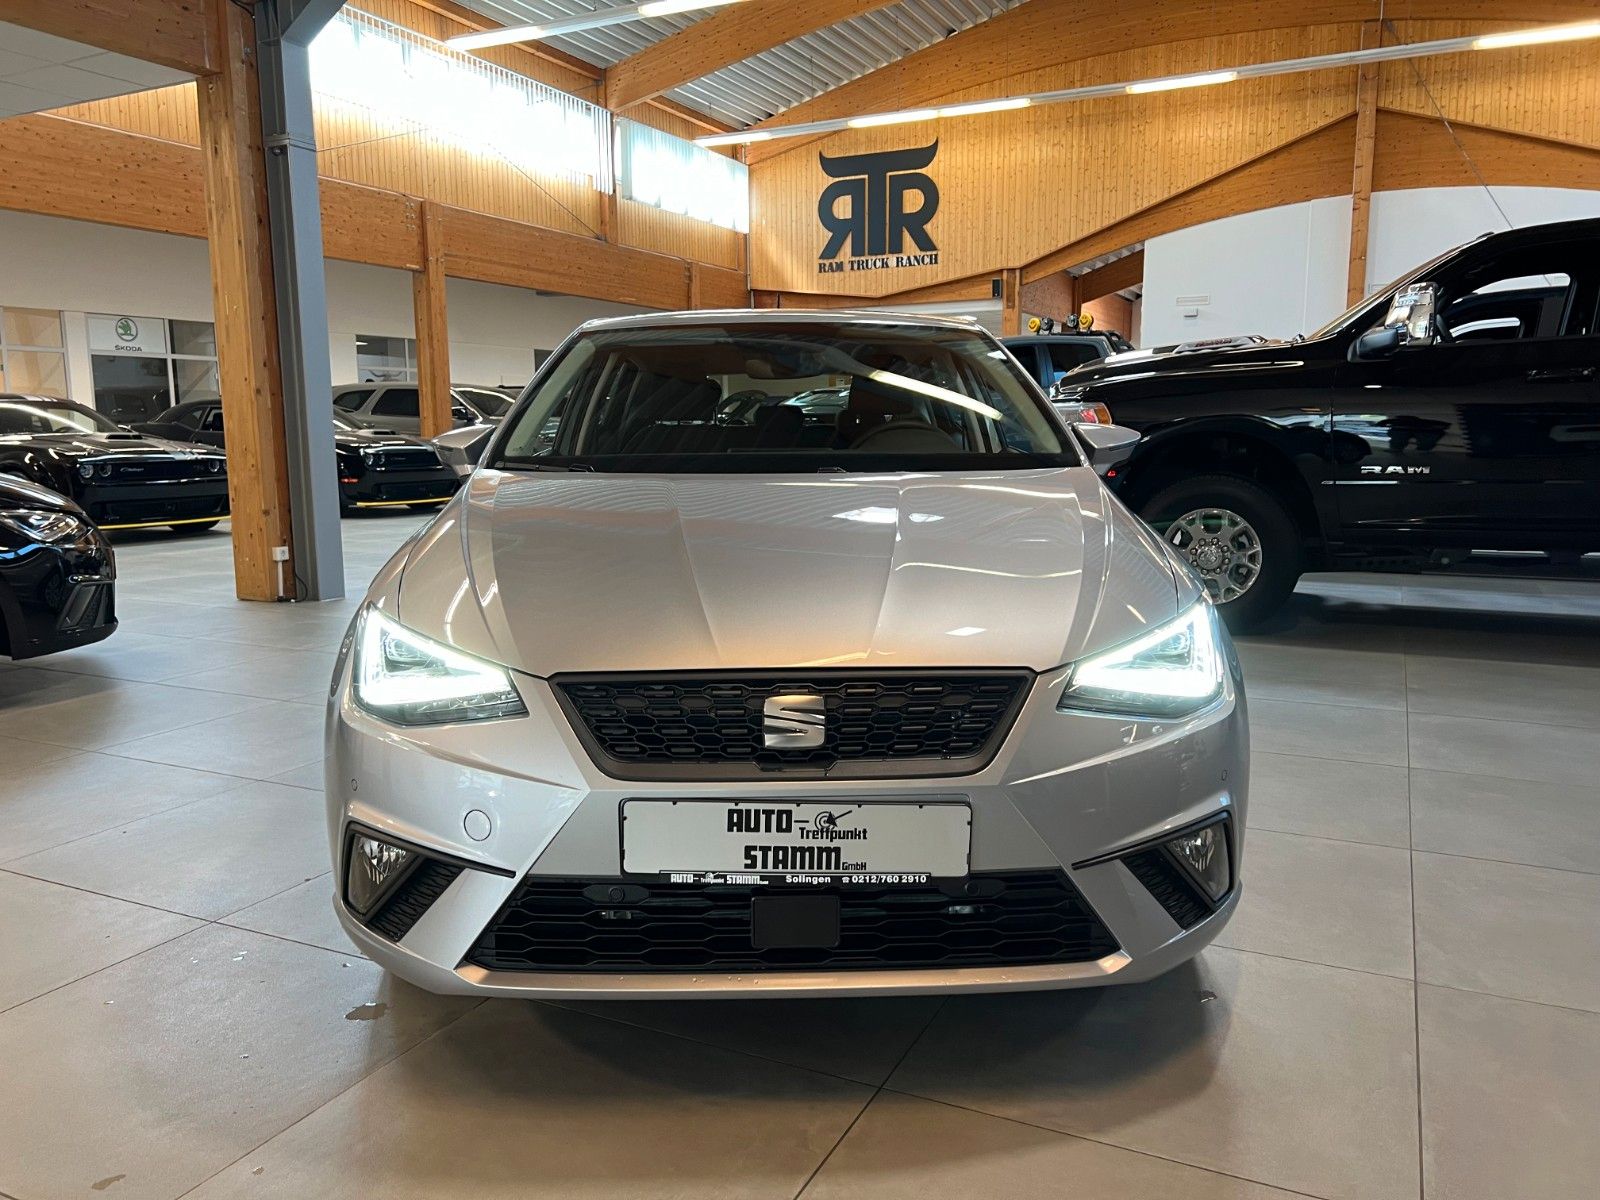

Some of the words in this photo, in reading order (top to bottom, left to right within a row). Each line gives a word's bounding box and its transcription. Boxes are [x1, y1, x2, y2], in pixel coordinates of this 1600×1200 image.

[818, 261, 844, 273] RAM
[849, 257, 890, 271] TRUCK
[895, 253, 939, 267] RANCH
[1360, 466, 1431, 474] RAM
[799, 827, 867, 842] Treffpunkt
[744, 845, 841, 870] STAMM
[842, 862, 867, 870] GmbH
[726, 875, 760, 884] STAMM
[785, 875, 831, 884] Solingen
[851, 875, 899, 884] 0212/760
[901, 875, 927, 883] 2910
